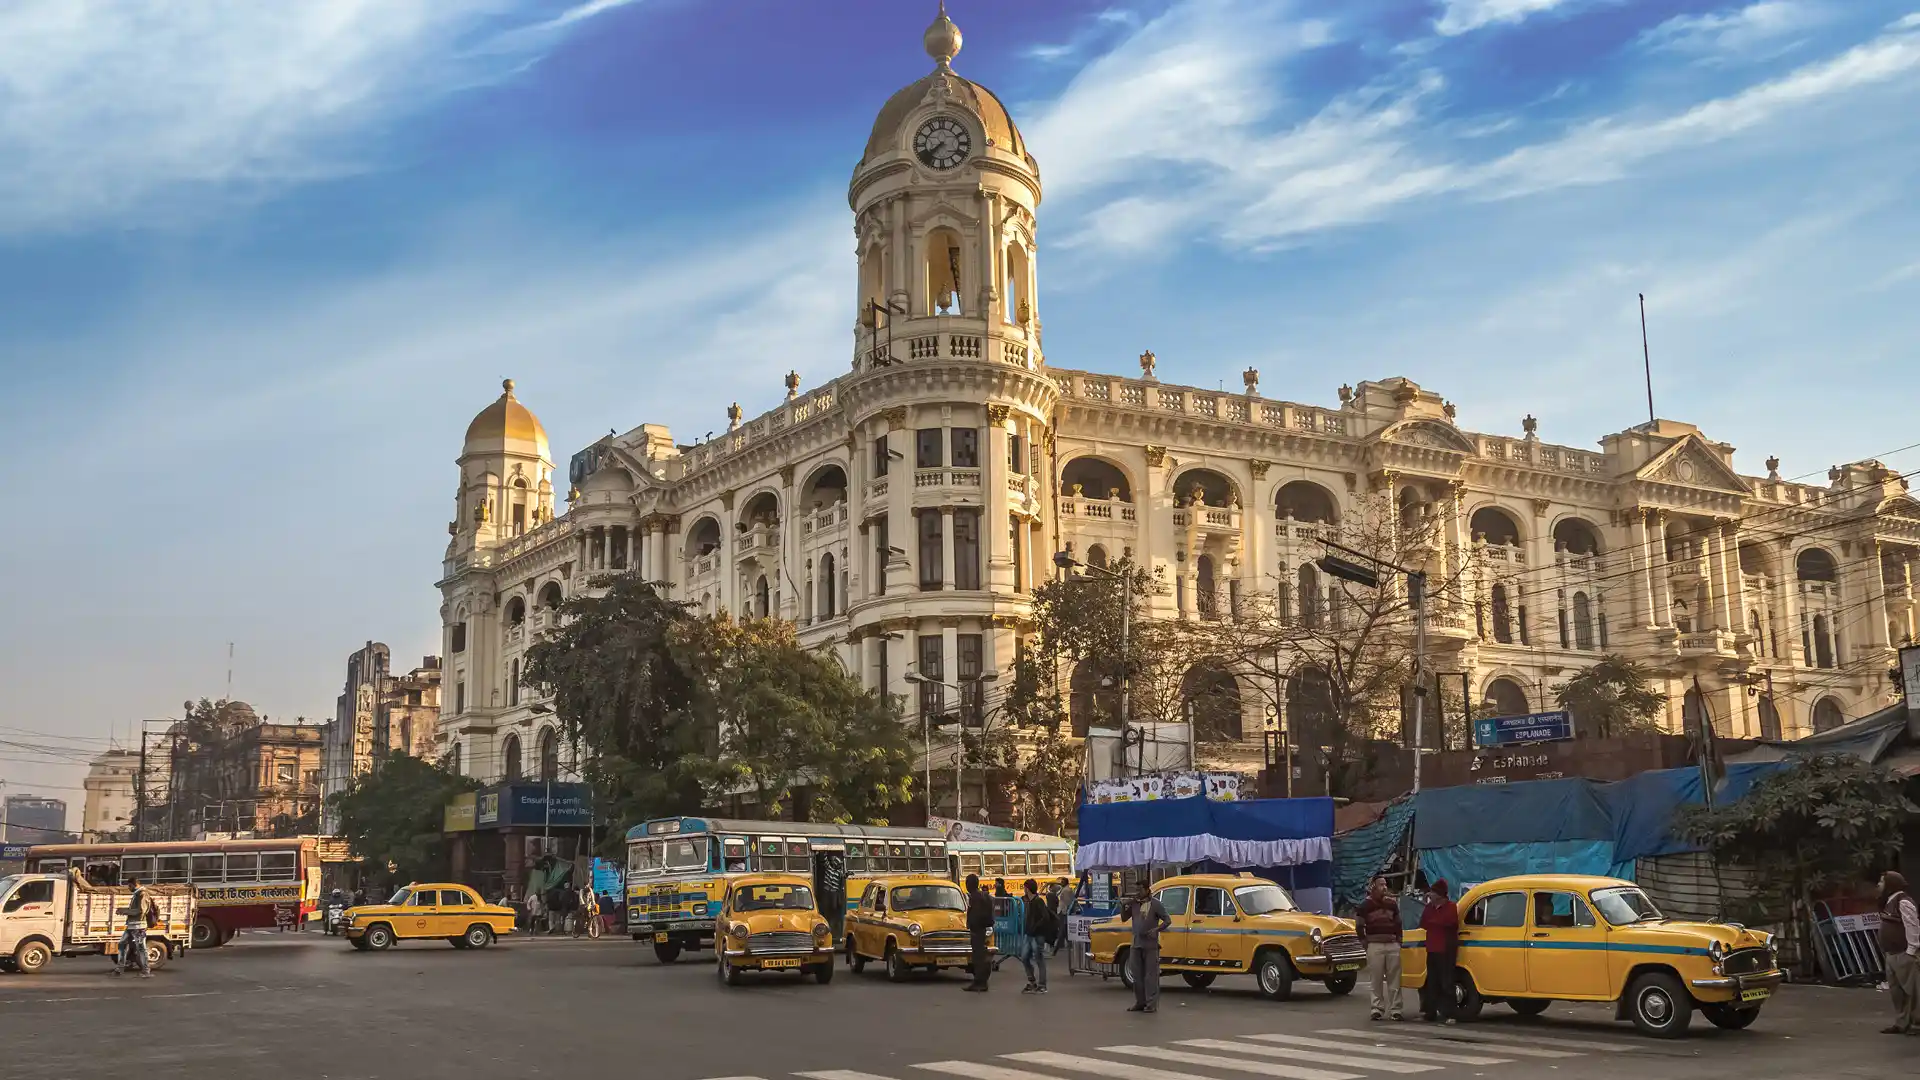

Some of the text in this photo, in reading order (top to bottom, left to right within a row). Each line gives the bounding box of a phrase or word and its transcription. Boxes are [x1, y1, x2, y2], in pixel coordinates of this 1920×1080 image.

[1515, 729, 1551, 739] ESPLANADE
[1493, 753, 1548, 768] Esplanade
[521, 796, 555, 806] Ensuring
[557, 808, 578, 816] every
[1159, 957, 1242, 967] PORTS
